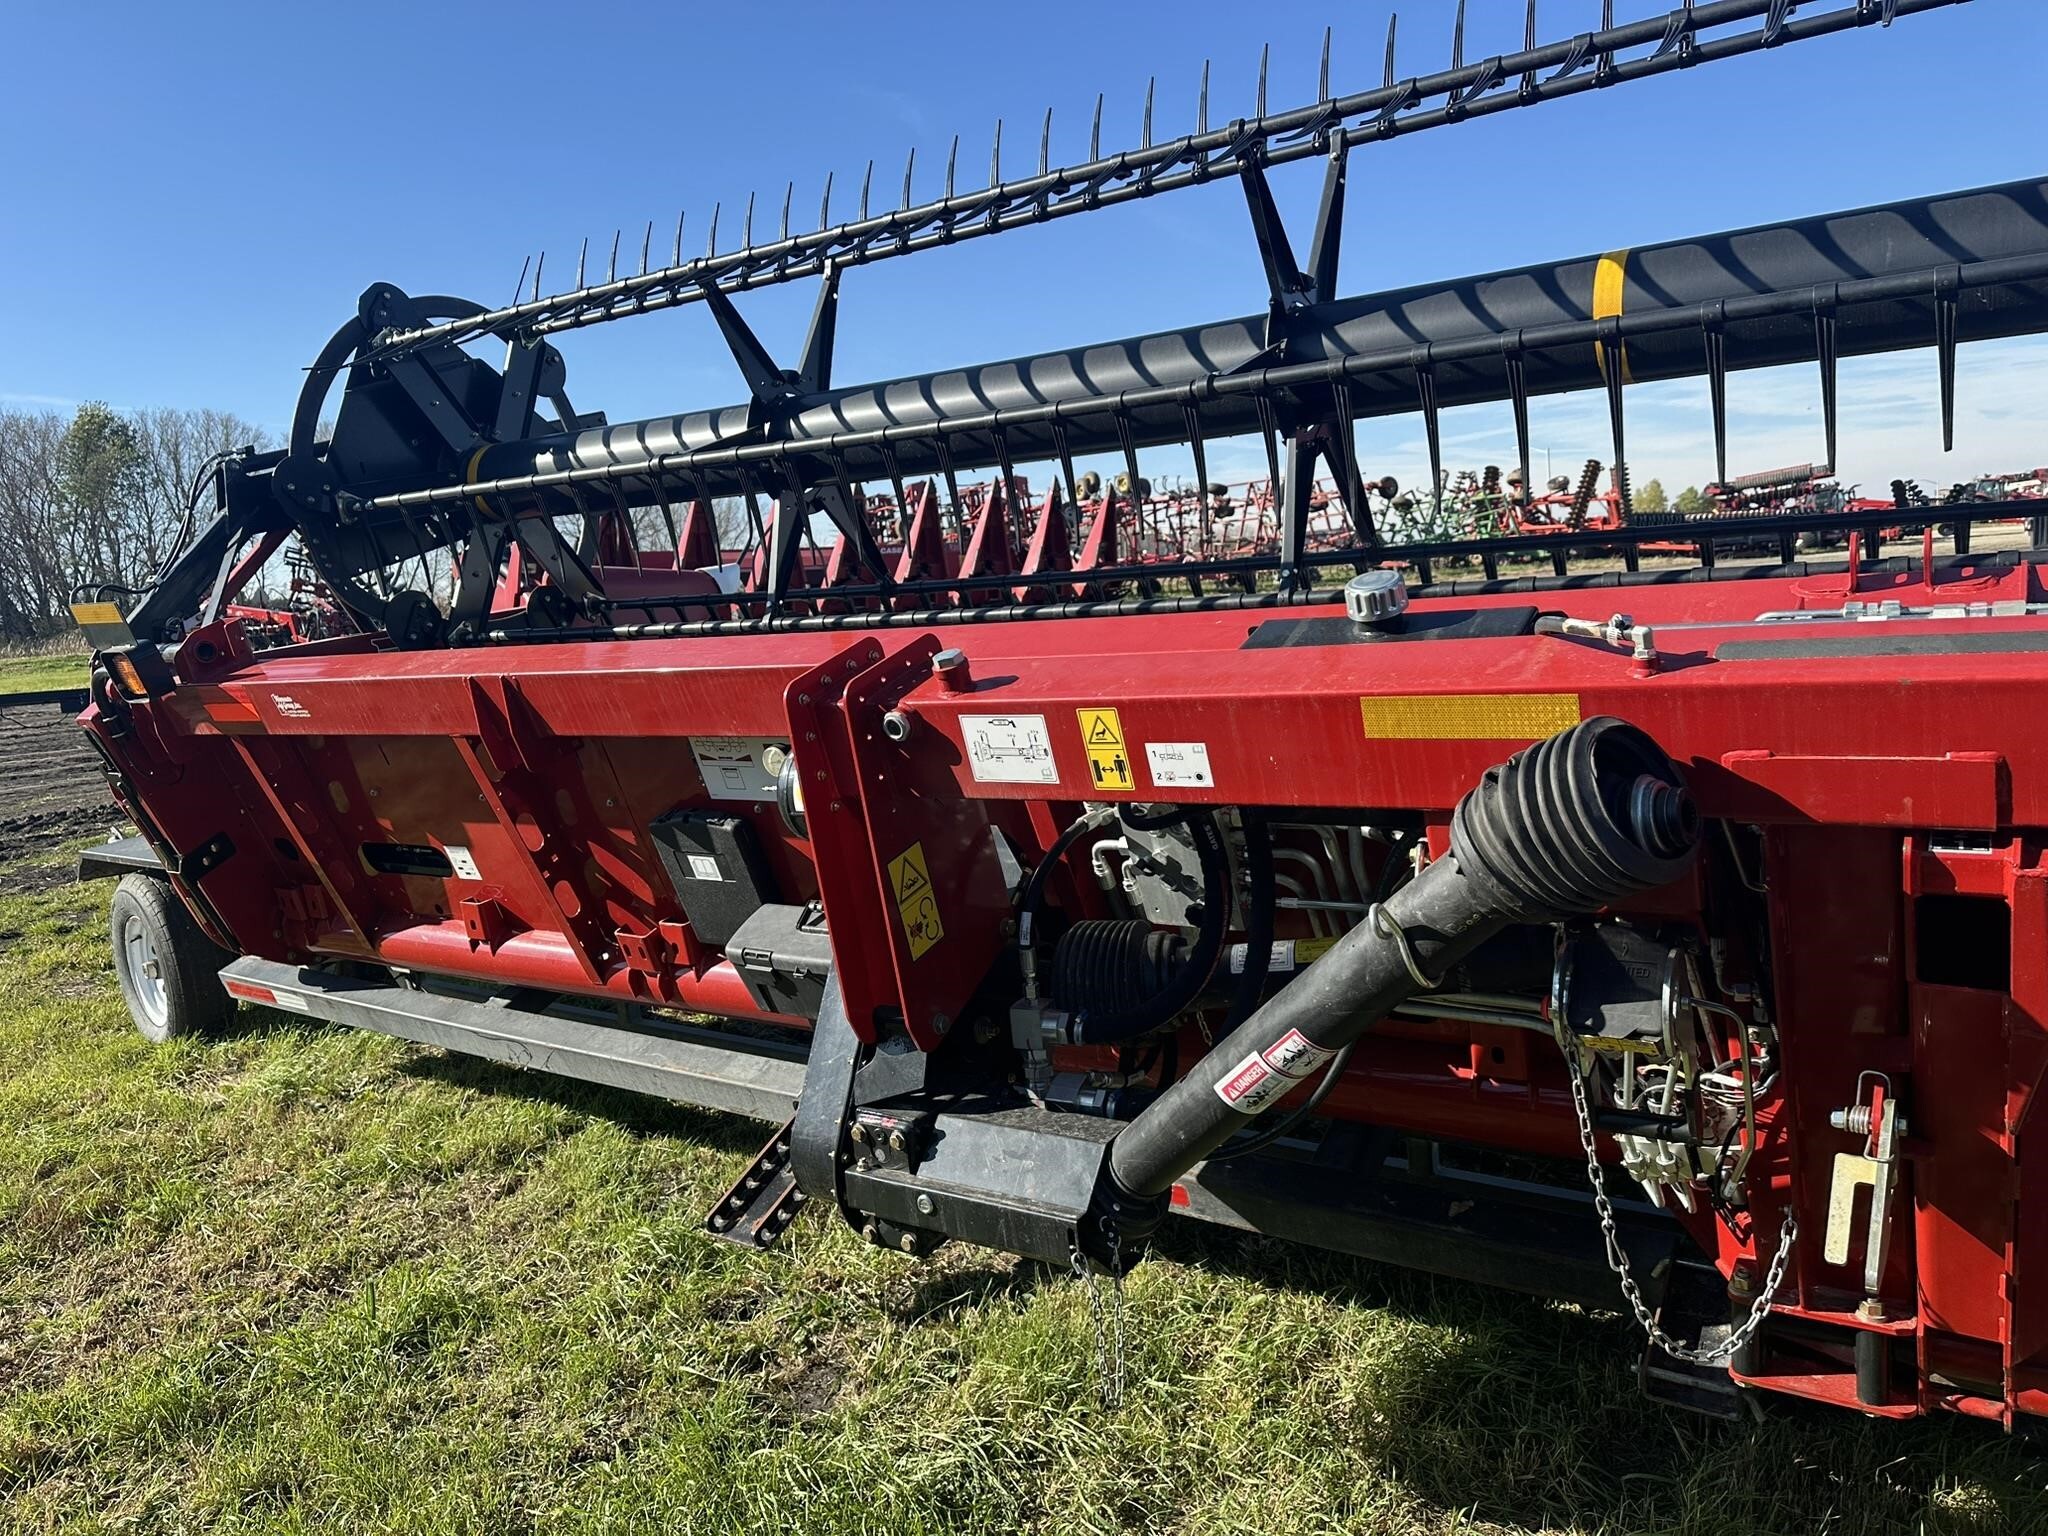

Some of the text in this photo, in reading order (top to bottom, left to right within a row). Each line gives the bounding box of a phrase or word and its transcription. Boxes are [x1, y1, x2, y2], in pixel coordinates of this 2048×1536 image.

[880, 546, 902, 554] CASE
[1152, 750, 1157, 758] 1
[1156, 772, 1163, 780] 2
[1234, 1064, 1265, 1091] DANGER
